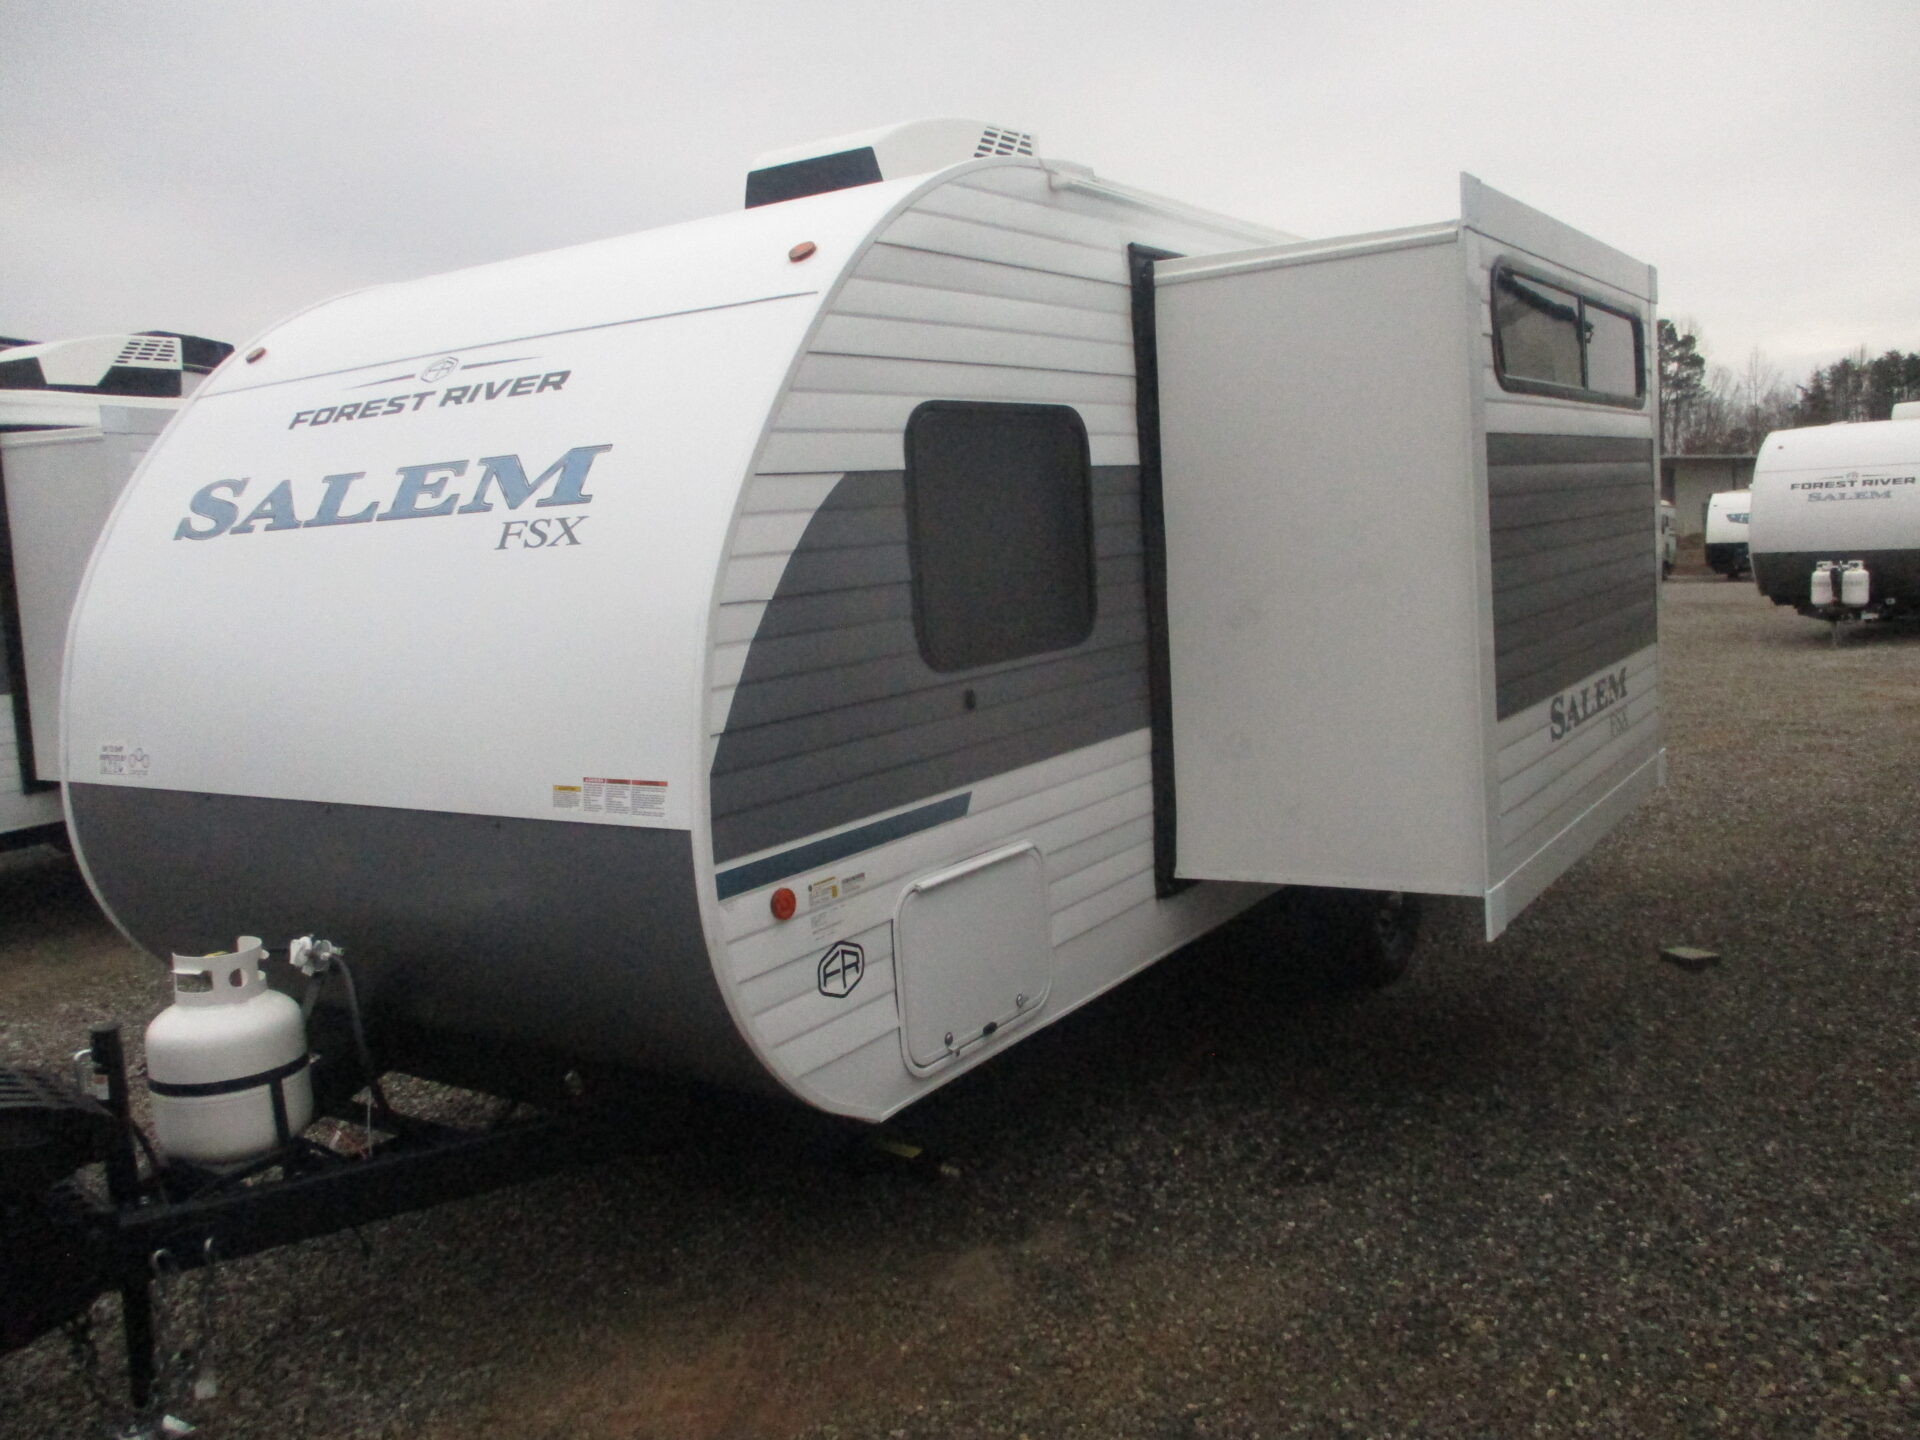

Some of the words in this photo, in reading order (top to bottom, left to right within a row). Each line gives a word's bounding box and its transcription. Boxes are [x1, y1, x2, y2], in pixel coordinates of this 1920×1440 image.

[288, 390, 437, 430] FOREST
[439, 369, 572, 407] RIVER
[173, 443, 614, 542] SALEM
[1790, 480, 1858, 491] FOREST
[1862, 476, 1916, 487] RIVER
[1807, 490, 1892, 502] SALEM
[494, 515, 590, 551] FSX
[1550, 666, 1628, 742] SALEM
